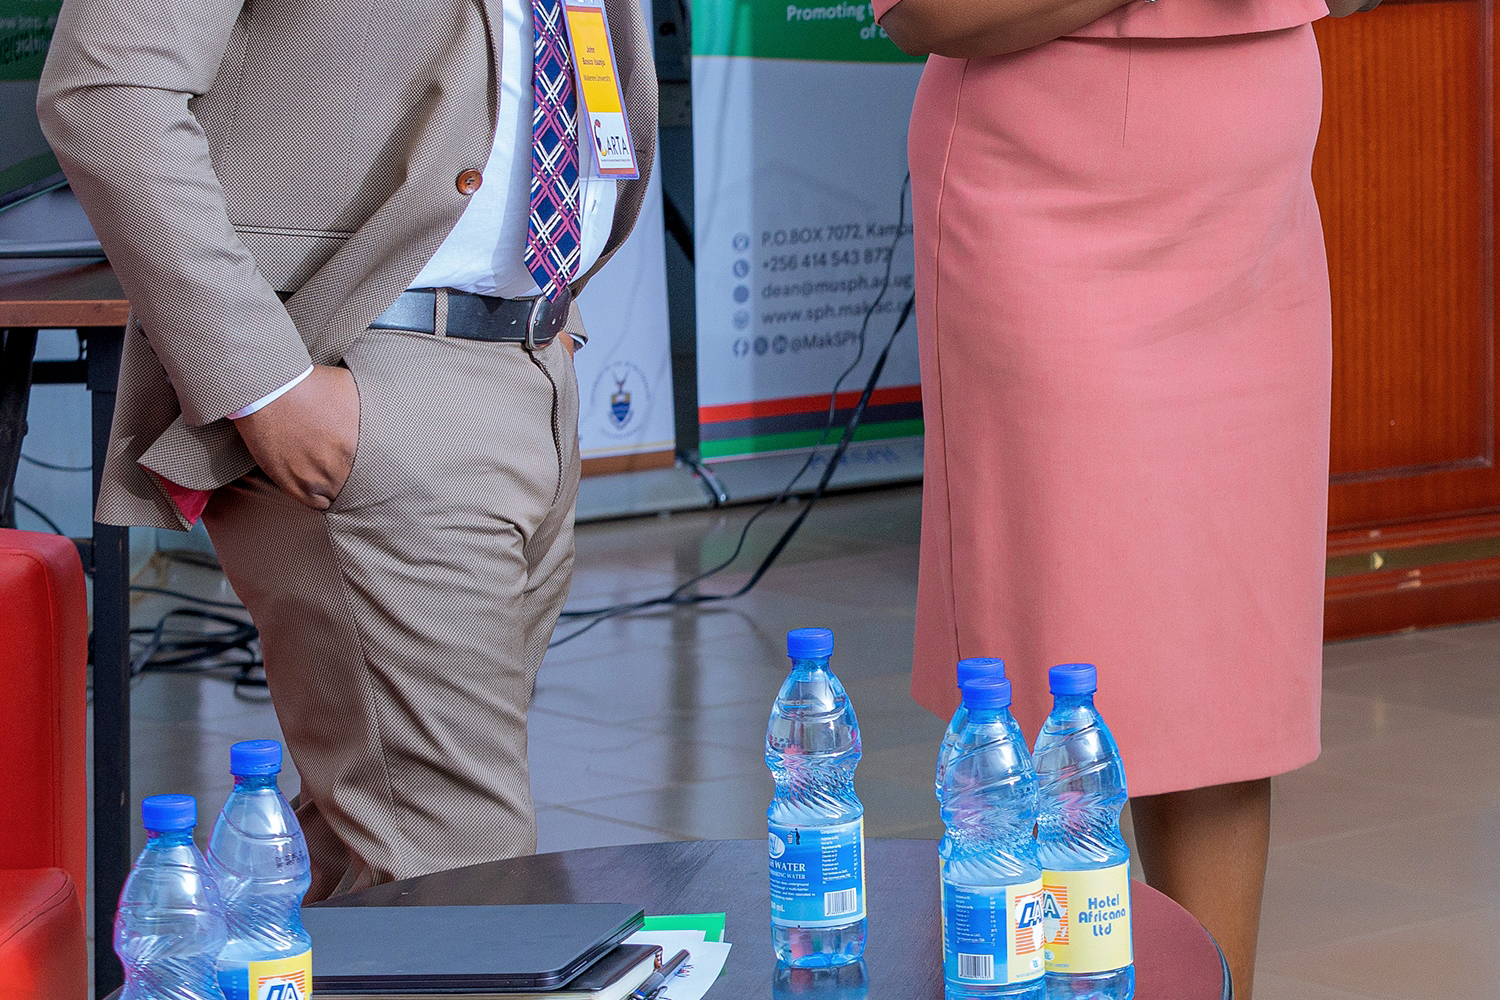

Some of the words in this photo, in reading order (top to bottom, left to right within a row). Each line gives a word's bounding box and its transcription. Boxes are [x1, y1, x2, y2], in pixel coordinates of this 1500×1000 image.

[787, 1, 865, 22] Promoting
[860, 22, 876, 40] of
[763, 254, 798, 272] +256
[801, 253, 827, 268] 414
[831, 250, 860, 267] 543
[775, 861, 806, 872] WATER
[1088, 894, 1120, 910] Hotel
[1078, 907, 1126, 924] Africana
[1093, 924, 1112, 937] Ltd
